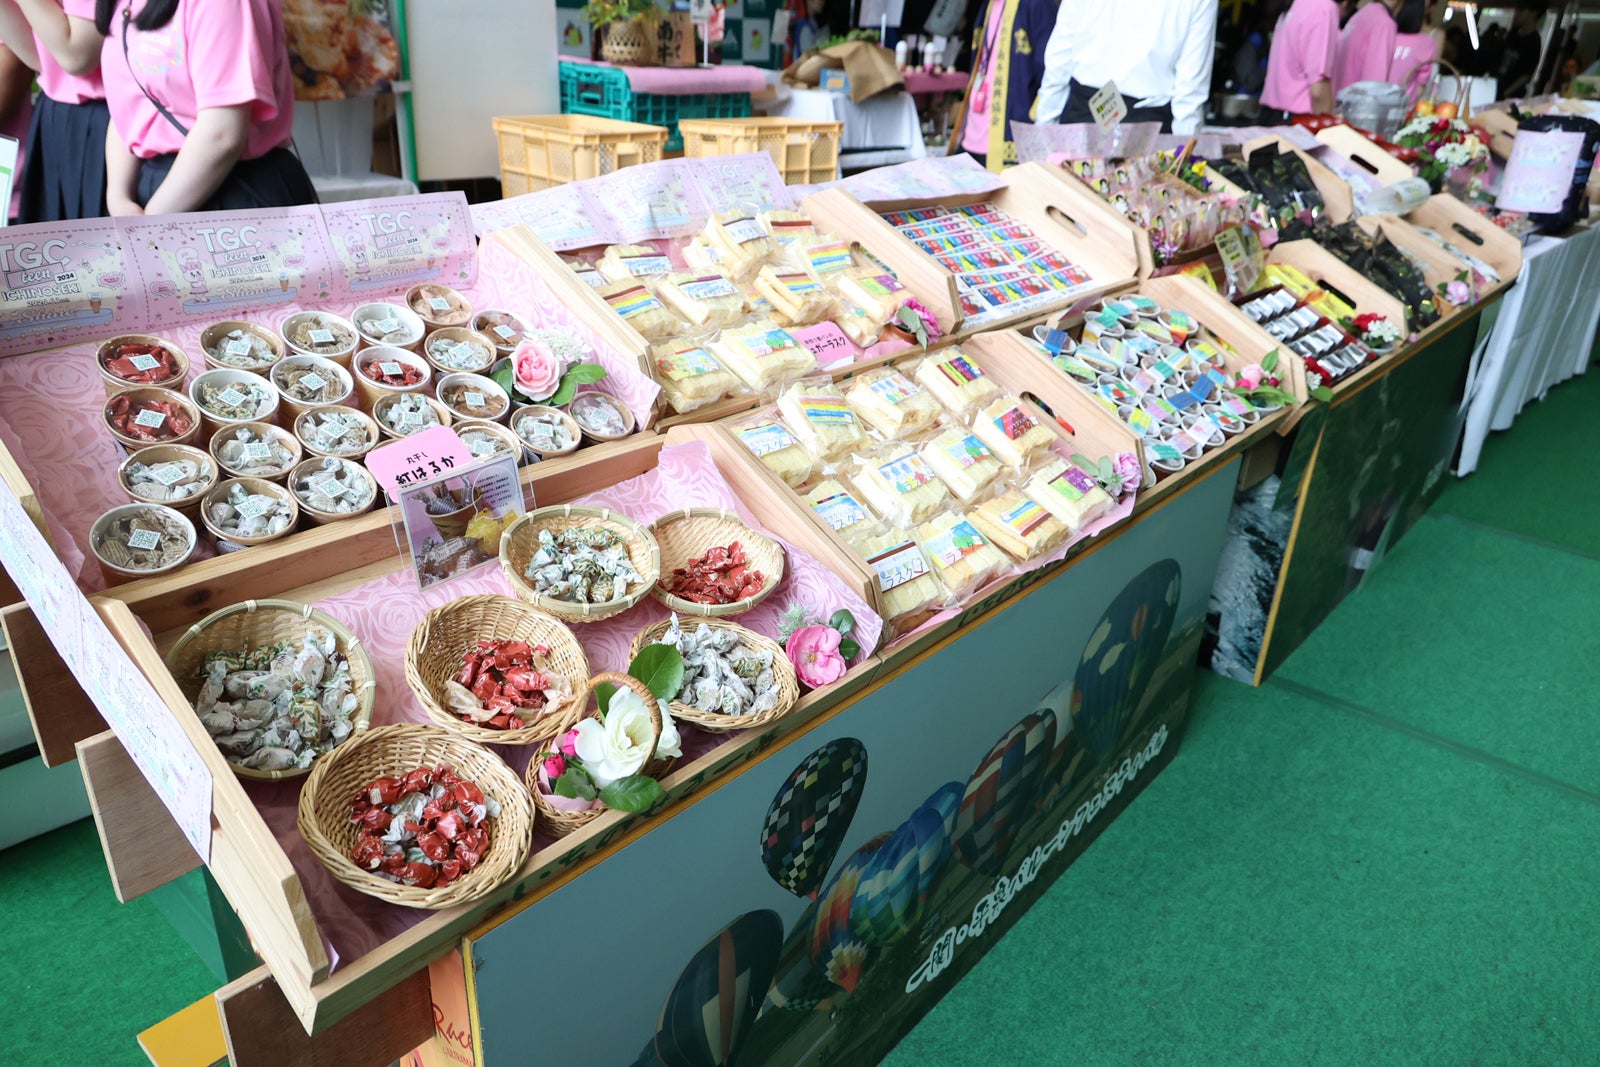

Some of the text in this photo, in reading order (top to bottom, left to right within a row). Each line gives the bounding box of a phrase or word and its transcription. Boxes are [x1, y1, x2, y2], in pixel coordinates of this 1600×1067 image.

[360, 209, 415, 237] TGC
[195, 224, 262, 253] TGC
[0, 238, 71, 272] TGC
[223, 251, 249, 264] teen
[21, 267, 75, 284] teen 2024
[209, 262, 273, 279] ICHINOSEKI
[2, 282, 81, 302] ICHINOSEKI
[811, 336, 846, 354] ュガーラスク
[406, 451, 429, 465] 丸干し
[395, 455, 455, 485] 紅はるか
[885, 567, 913, 590] ラスク
